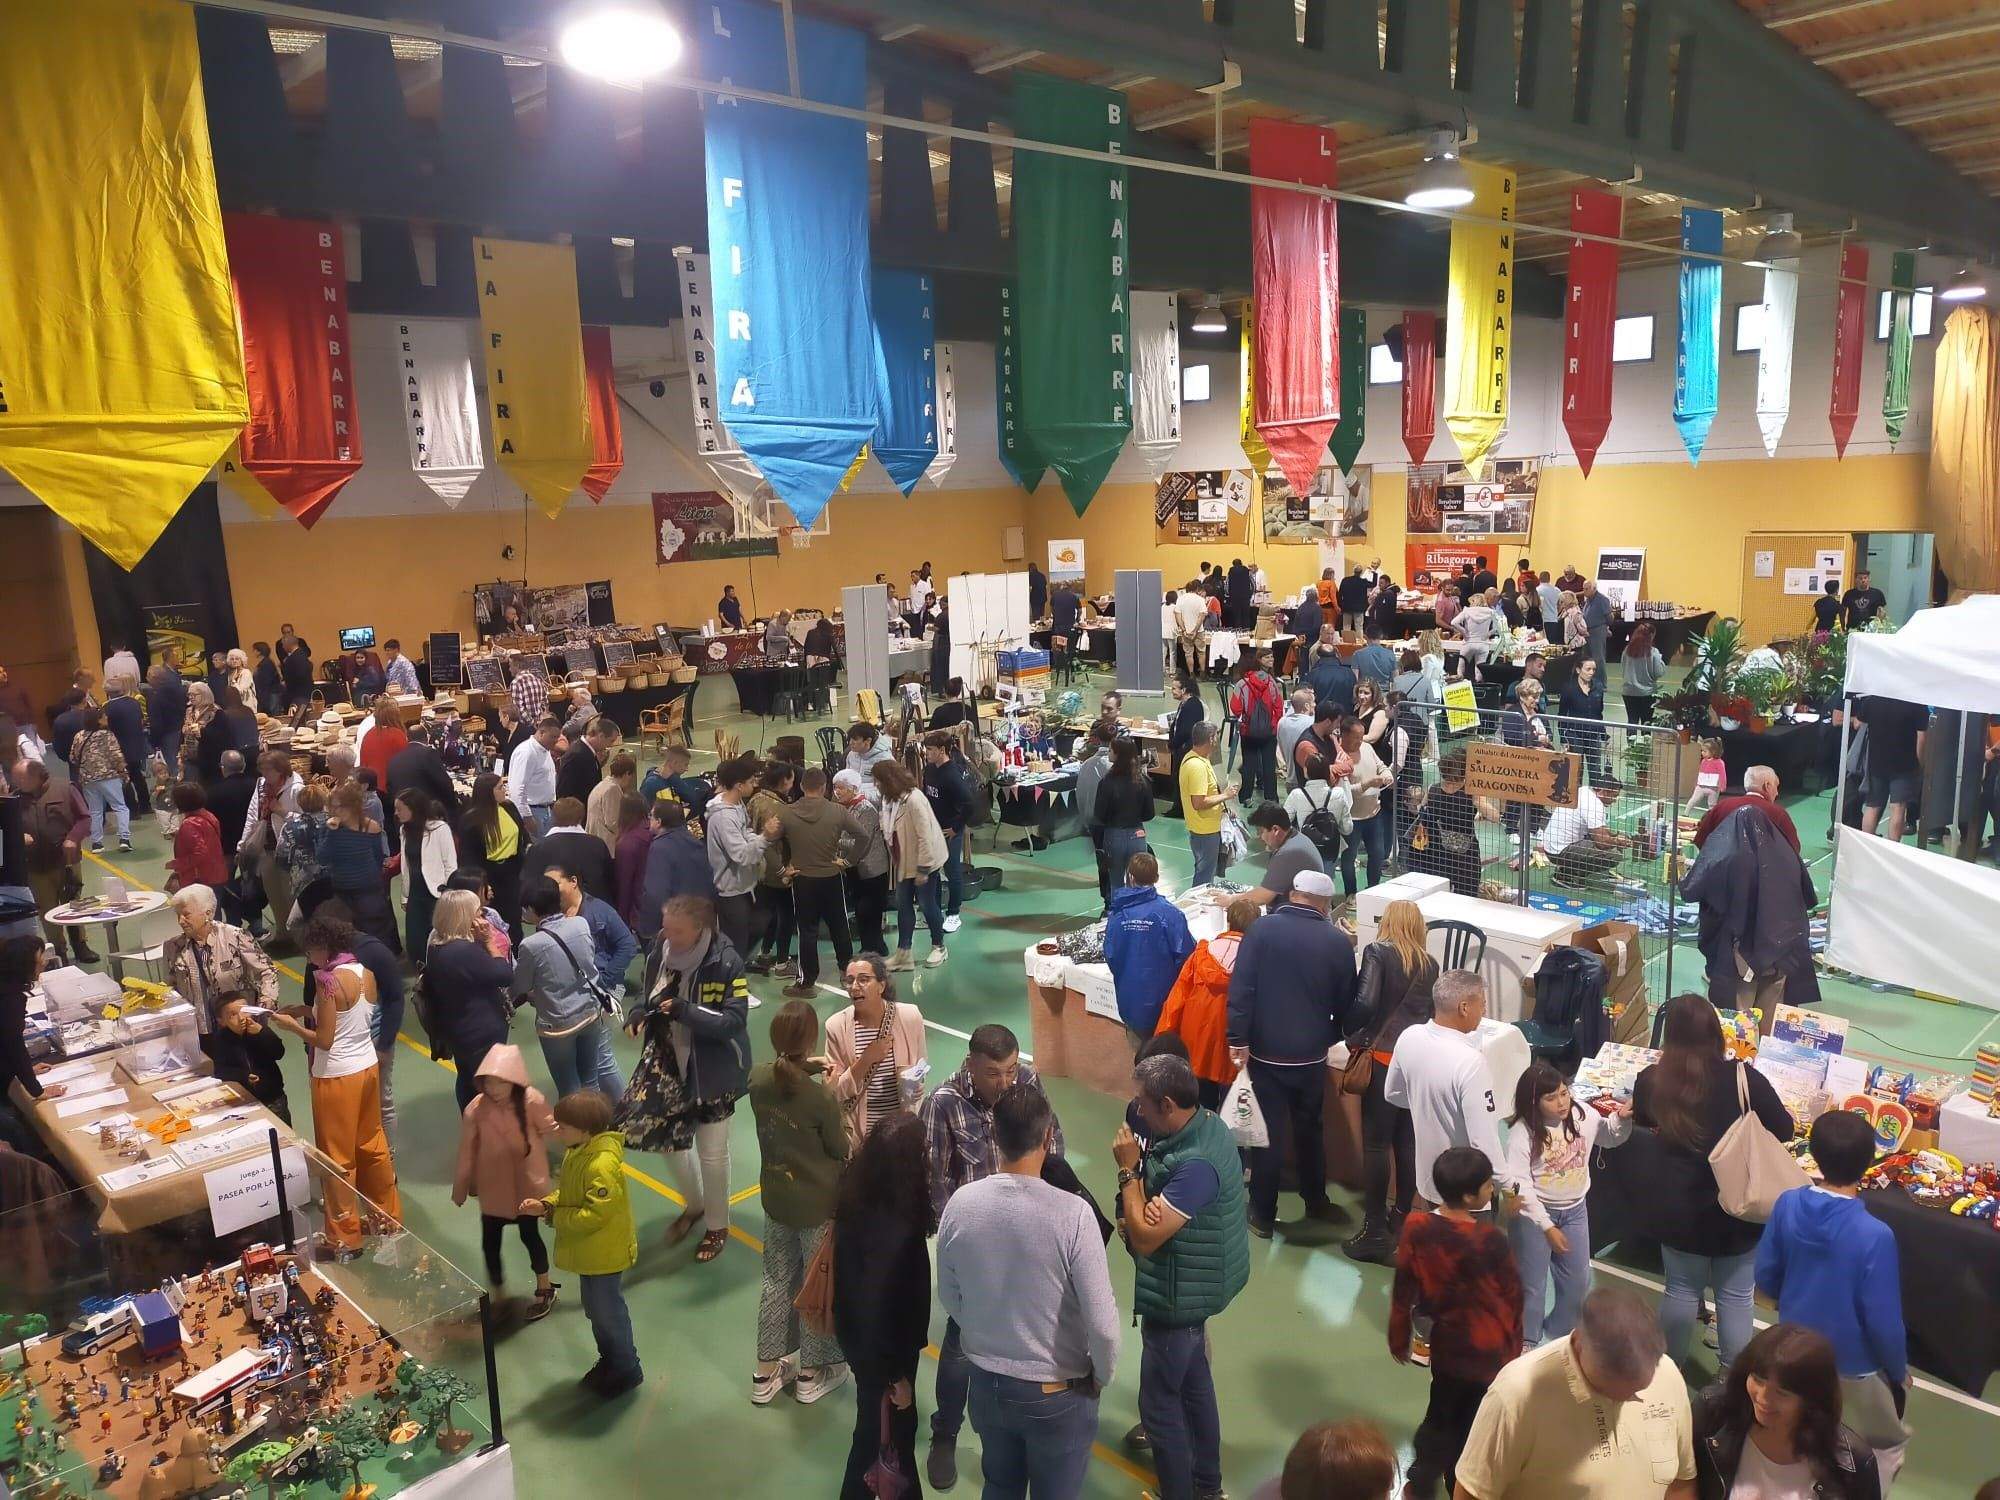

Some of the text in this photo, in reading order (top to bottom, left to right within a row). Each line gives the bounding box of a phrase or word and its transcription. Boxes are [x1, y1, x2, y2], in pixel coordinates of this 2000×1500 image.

[722, 177, 755, 407] FIRA
[1108, 103, 1125, 423] BENABARRE
[1168, 296, 1175, 332] LA
[1494, 178, 1511, 414] BENABARRE
[318, 232, 351, 461] BENABARRE
[400, 325, 427, 468] BENABARRE
[481, 244, 514, 454] LA FIRA
[685, 260, 715, 452] BENABARRE
[920, 277, 933, 445] LA FIRA
[945, 346, 954, 454] LA FIRA
[1002, 288, 1014, 449] BENABARRE
[1567, 286, 1582, 410] FIRA
[1469, 763, 1540, 780] SALAZONERA
[1469, 779, 1536, 796] ARAGONESA
[1484, 1089, 1496, 1112] 3
[218, 1189, 244, 1202] PASEA
[245, 1182, 263, 1193] POR
[264, 1179, 275, 1188] LA
